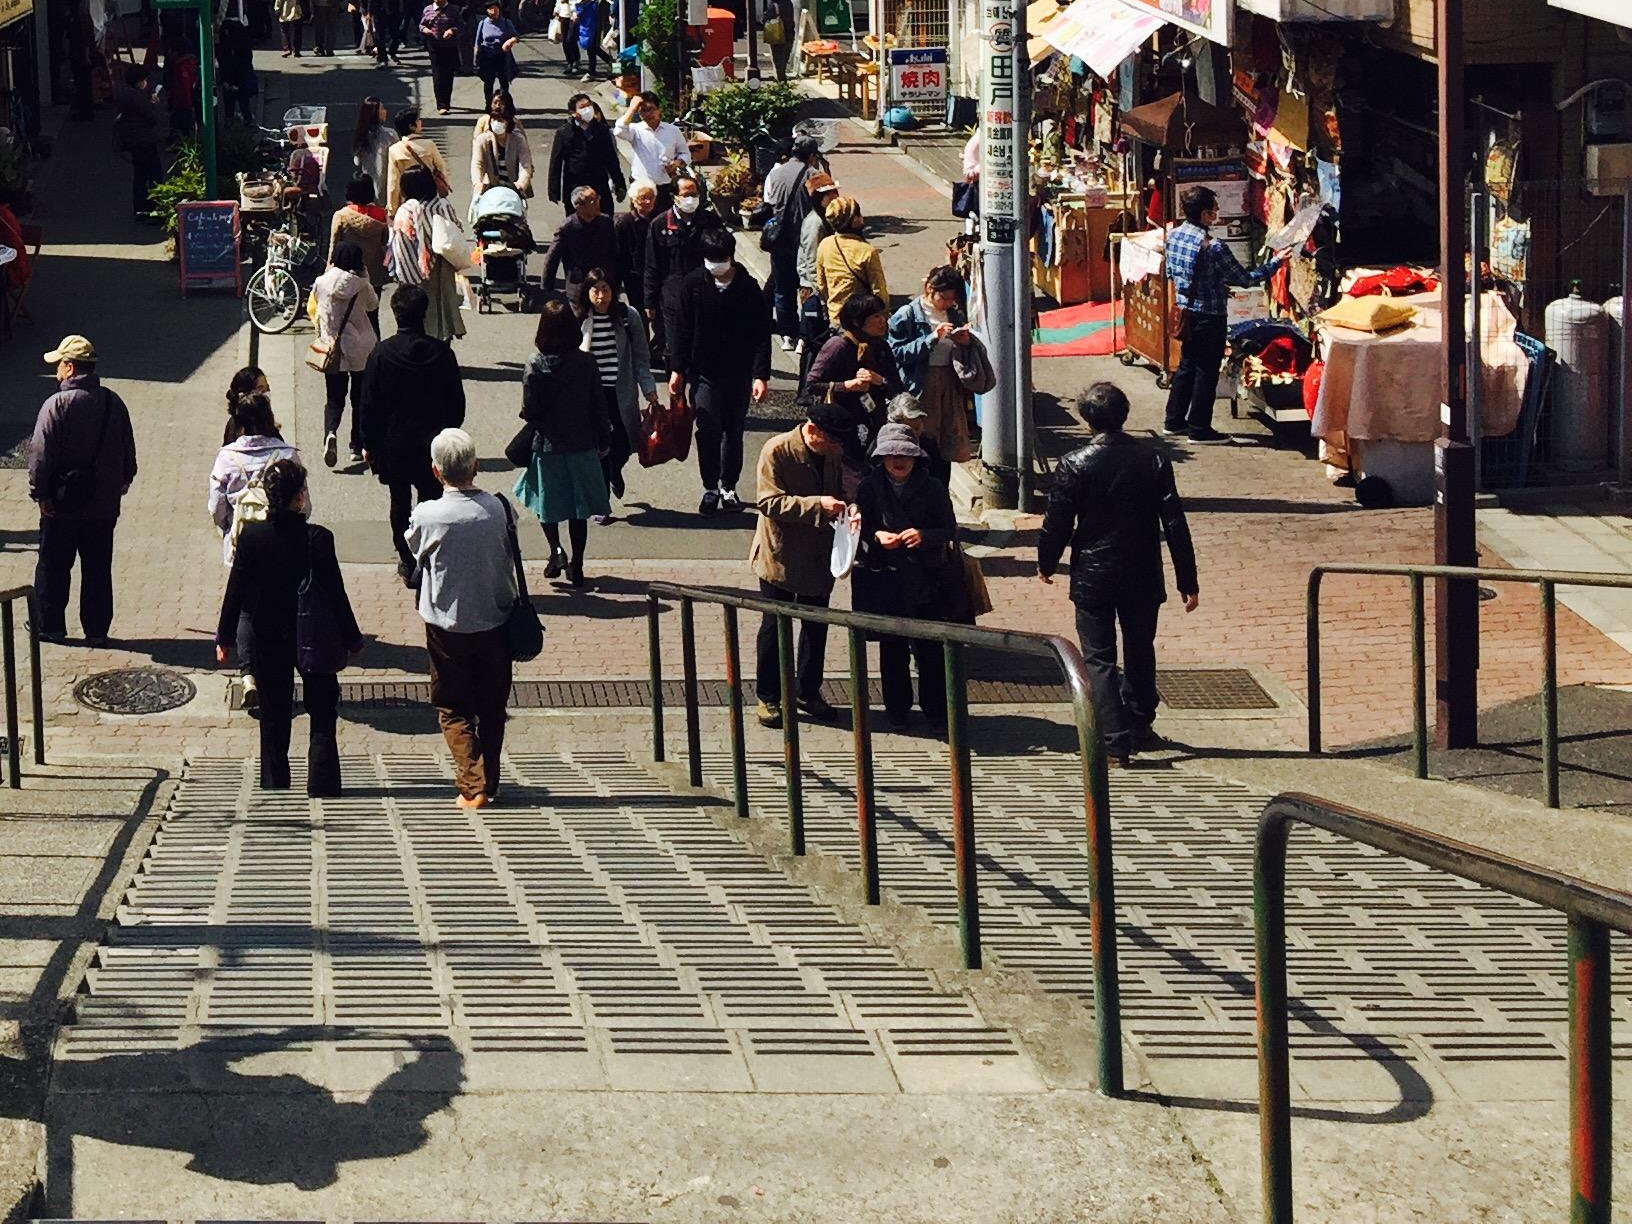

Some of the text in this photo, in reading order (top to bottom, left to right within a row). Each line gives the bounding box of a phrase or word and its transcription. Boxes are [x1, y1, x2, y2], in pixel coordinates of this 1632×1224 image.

[900, 70, 940, 89] 焼肉
[900, 90, 941, 98] サラリーマン
